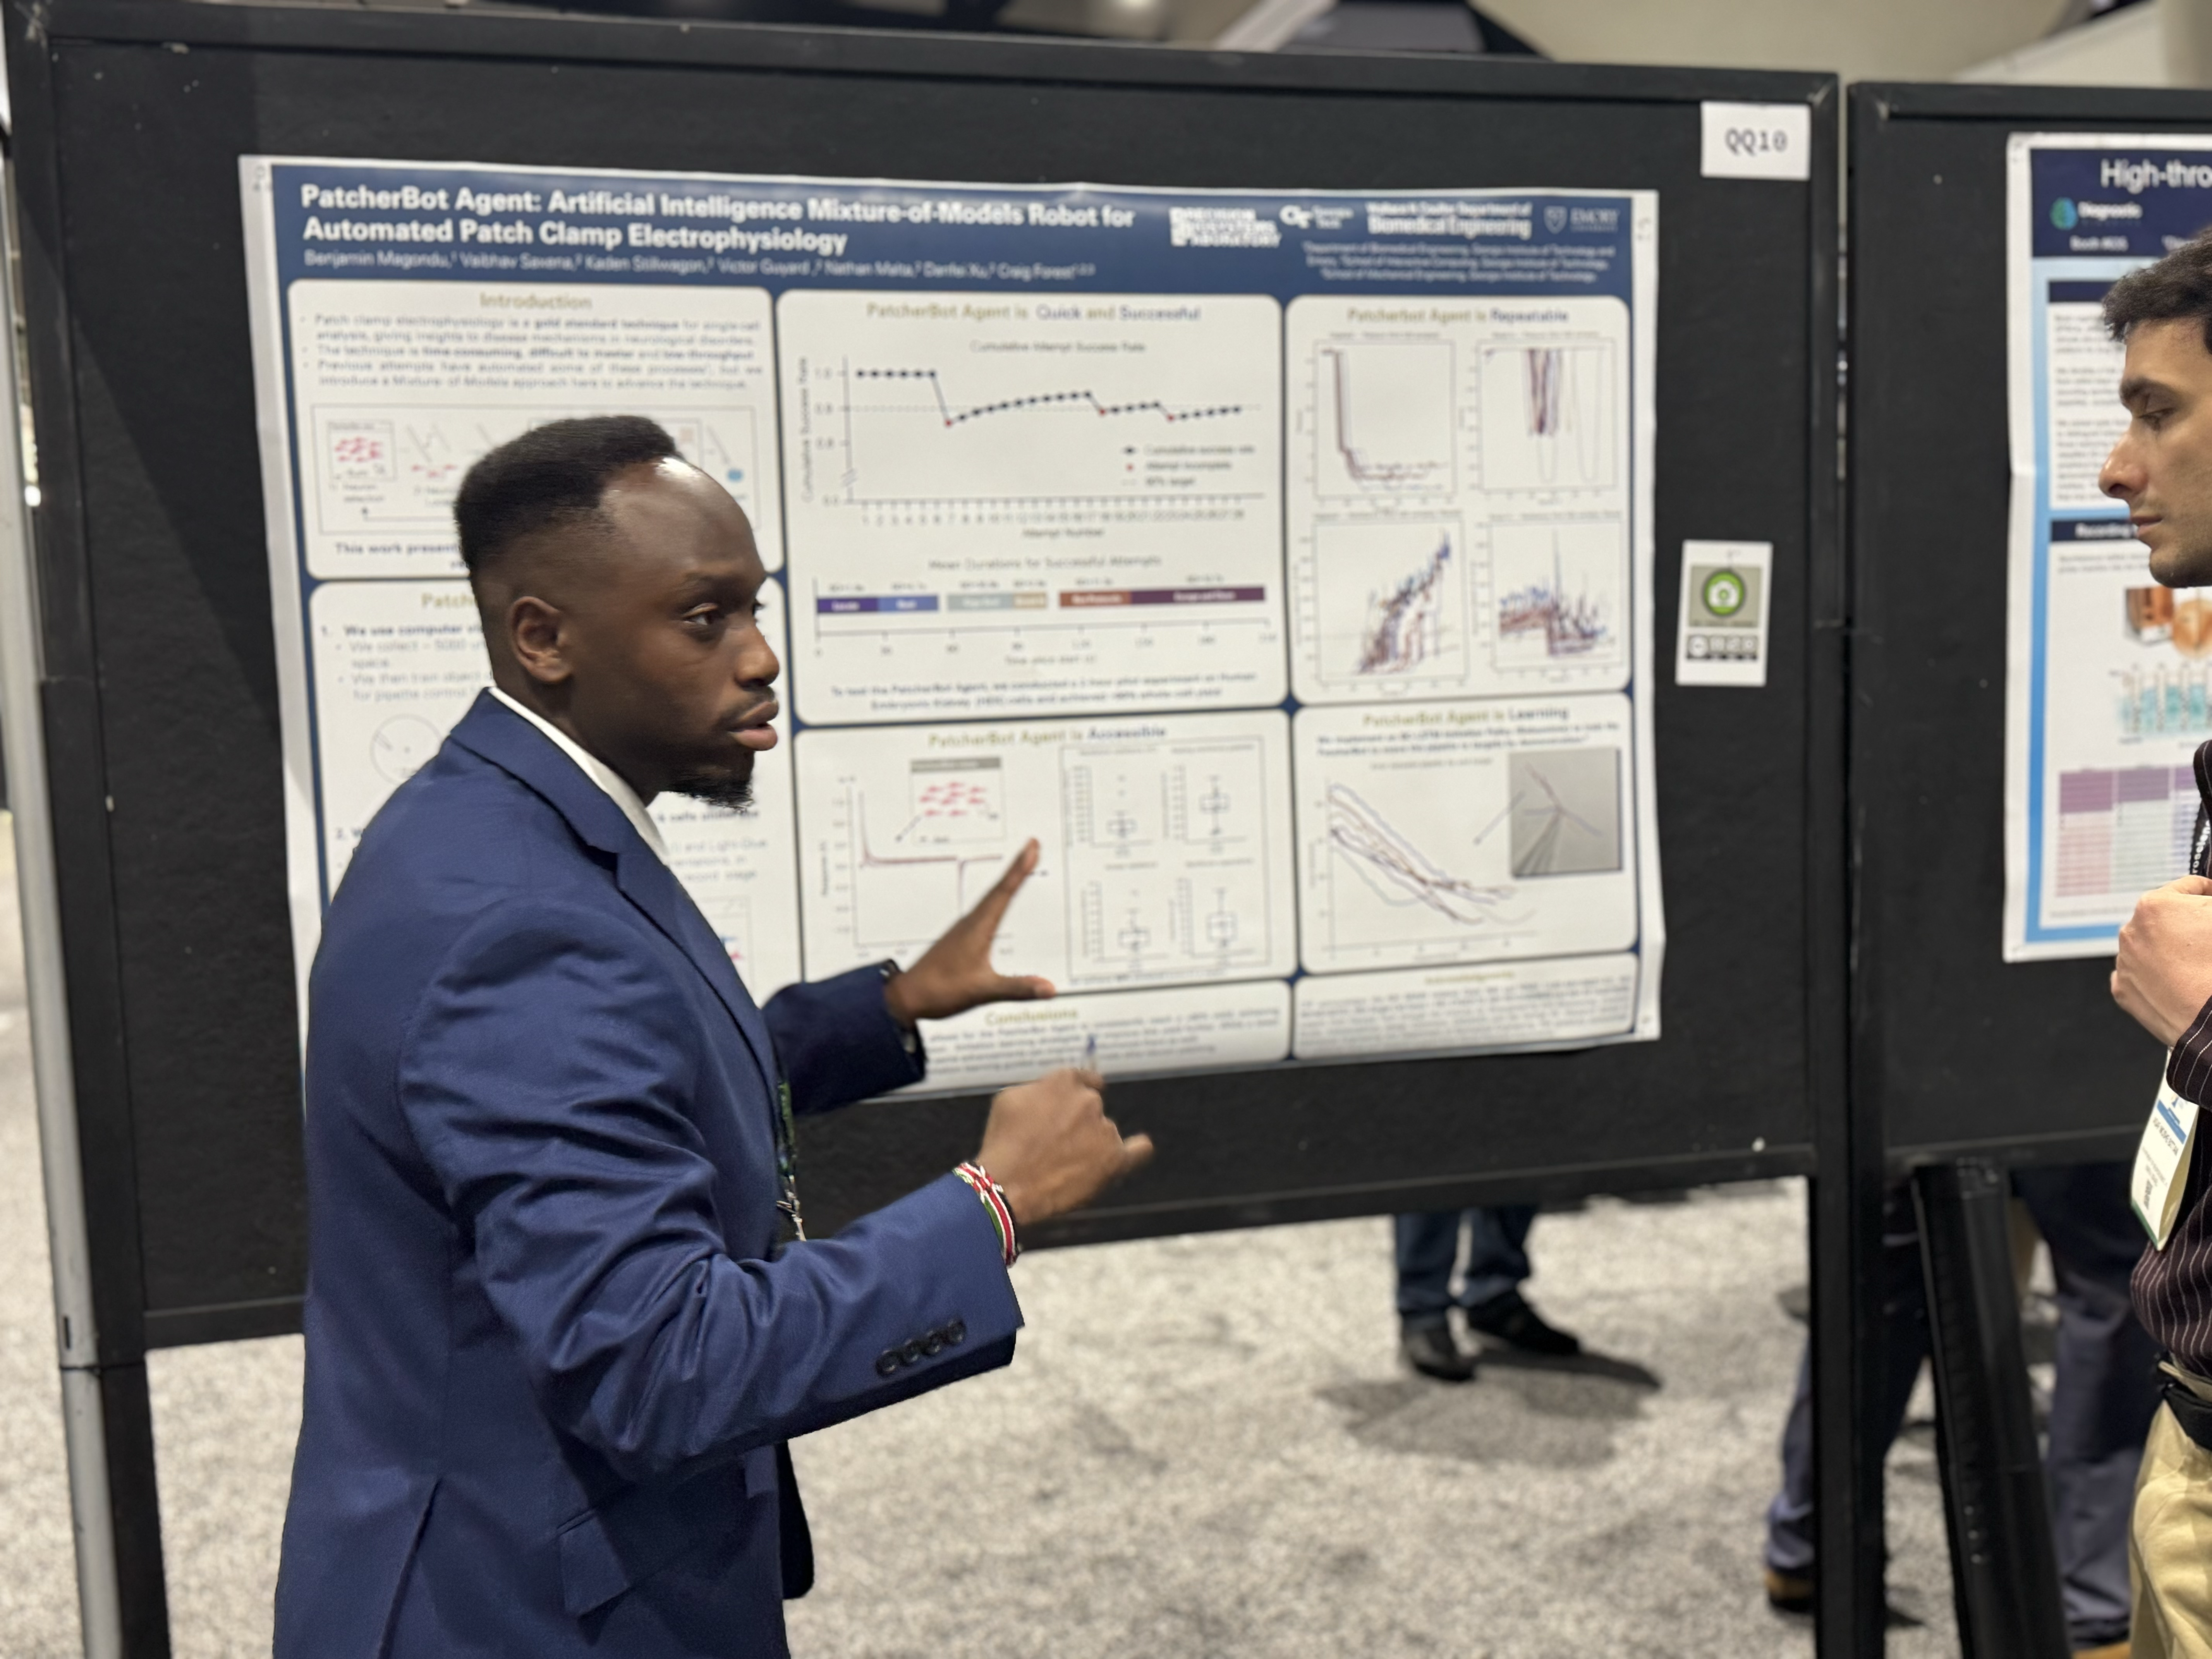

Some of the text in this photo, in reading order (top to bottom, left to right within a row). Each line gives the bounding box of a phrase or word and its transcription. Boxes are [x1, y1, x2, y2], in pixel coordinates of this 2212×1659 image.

[1725, 127, 1788, 156] QQ10
[301, 183, 1136, 228] PatcherBot Agent: Artificial Intelligence Mixture-of-Models Robot for
[1368, 215, 1532, 239] Biomedical Engineering
[303, 217, 847, 257] Automated Patch Clamp Electrophysiology
[304, 251, 374, 269] Benjamin
[460, 253, 517, 268] Vaibhav
[586, 255, 629, 270] Kaden
[718, 258, 758, 273] Victor
[825, 259, 872, 275] Nathan
[998, 263, 1032, 280] Craig
[480, 292, 593, 309] Introduction
[867, 303, 1201, 321] PatcherBot Agent is Quick and Successful
[1429, 309, 1472, 325] Agent
[1475, 309, 1488, 323] is
[1490, 309, 1570, 326] Repeatable
[335, 543, 364, 555] This
[368, 543, 402, 554] work
[344, 625, 366, 635] We
[371, 626, 394, 635] use
[398, 624, 462, 638] computer
[1363, 707, 1570, 726] PatcherBot Agent is Learning
[928, 726, 1167, 747] PatcherBot Agent is Accessible
[986, 1010, 1079, 1025] Conclusions
